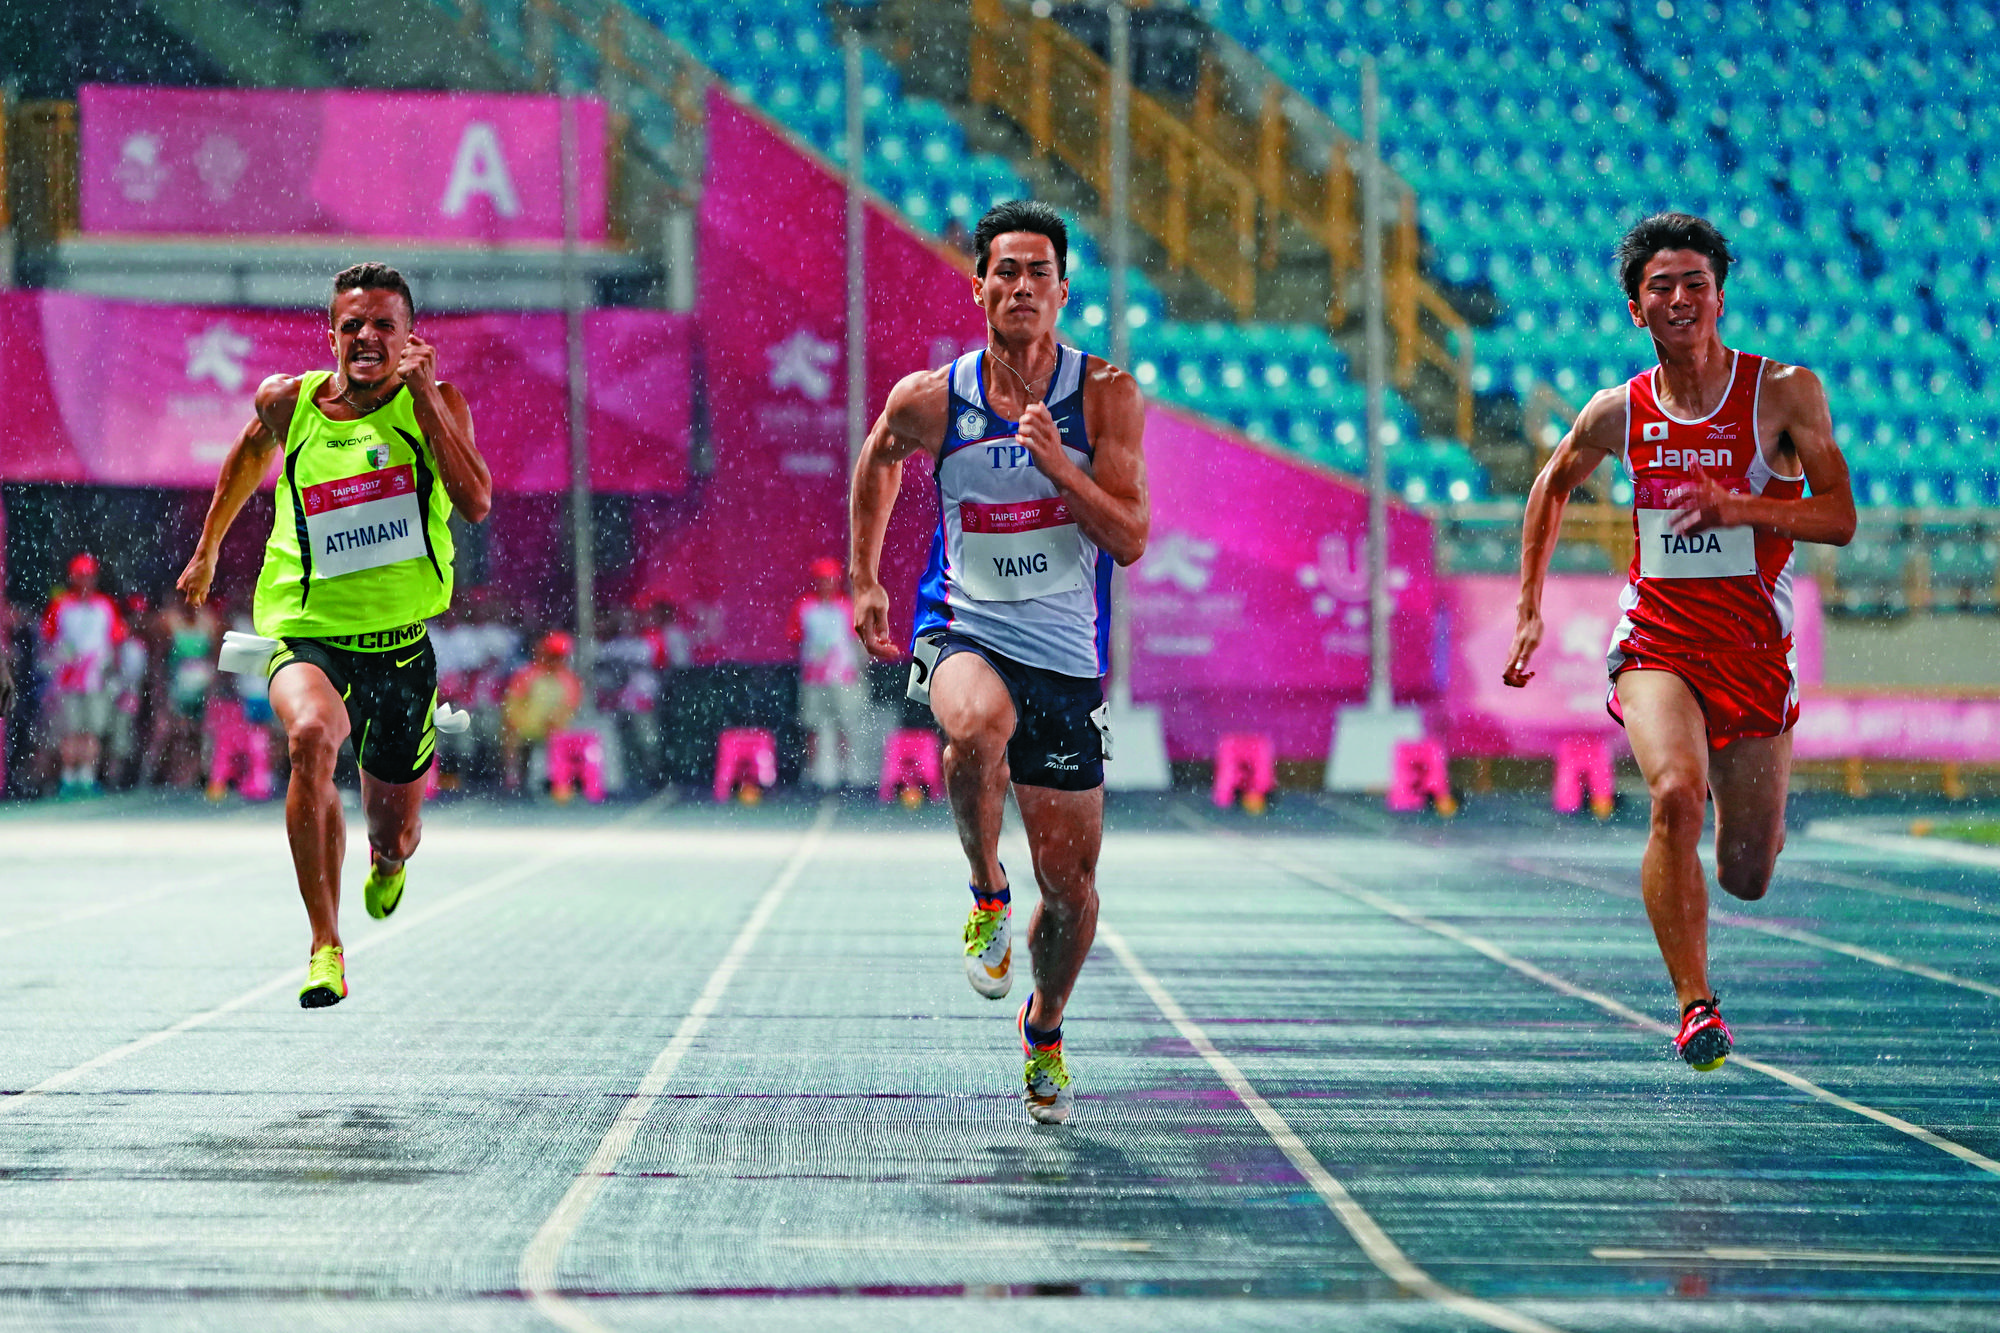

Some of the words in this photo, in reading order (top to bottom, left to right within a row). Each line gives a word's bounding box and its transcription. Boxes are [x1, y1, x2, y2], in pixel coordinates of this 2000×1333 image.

[443, 123, 522, 218] A
[326, 434, 372, 448] GIVOVA
[1648, 445, 1733, 472] Japan
[331, 485, 359, 497] TAIPEI
[360, 479, 381, 491] 2017
[989, 512, 1018, 522] TAIPEI
[1020, 508, 1041, 519] 2017
[326, 518, 409, 555] ATHMANI
[1660, 533, 1722, 554] TADA
[992, 552, 1048, 577] YANG
